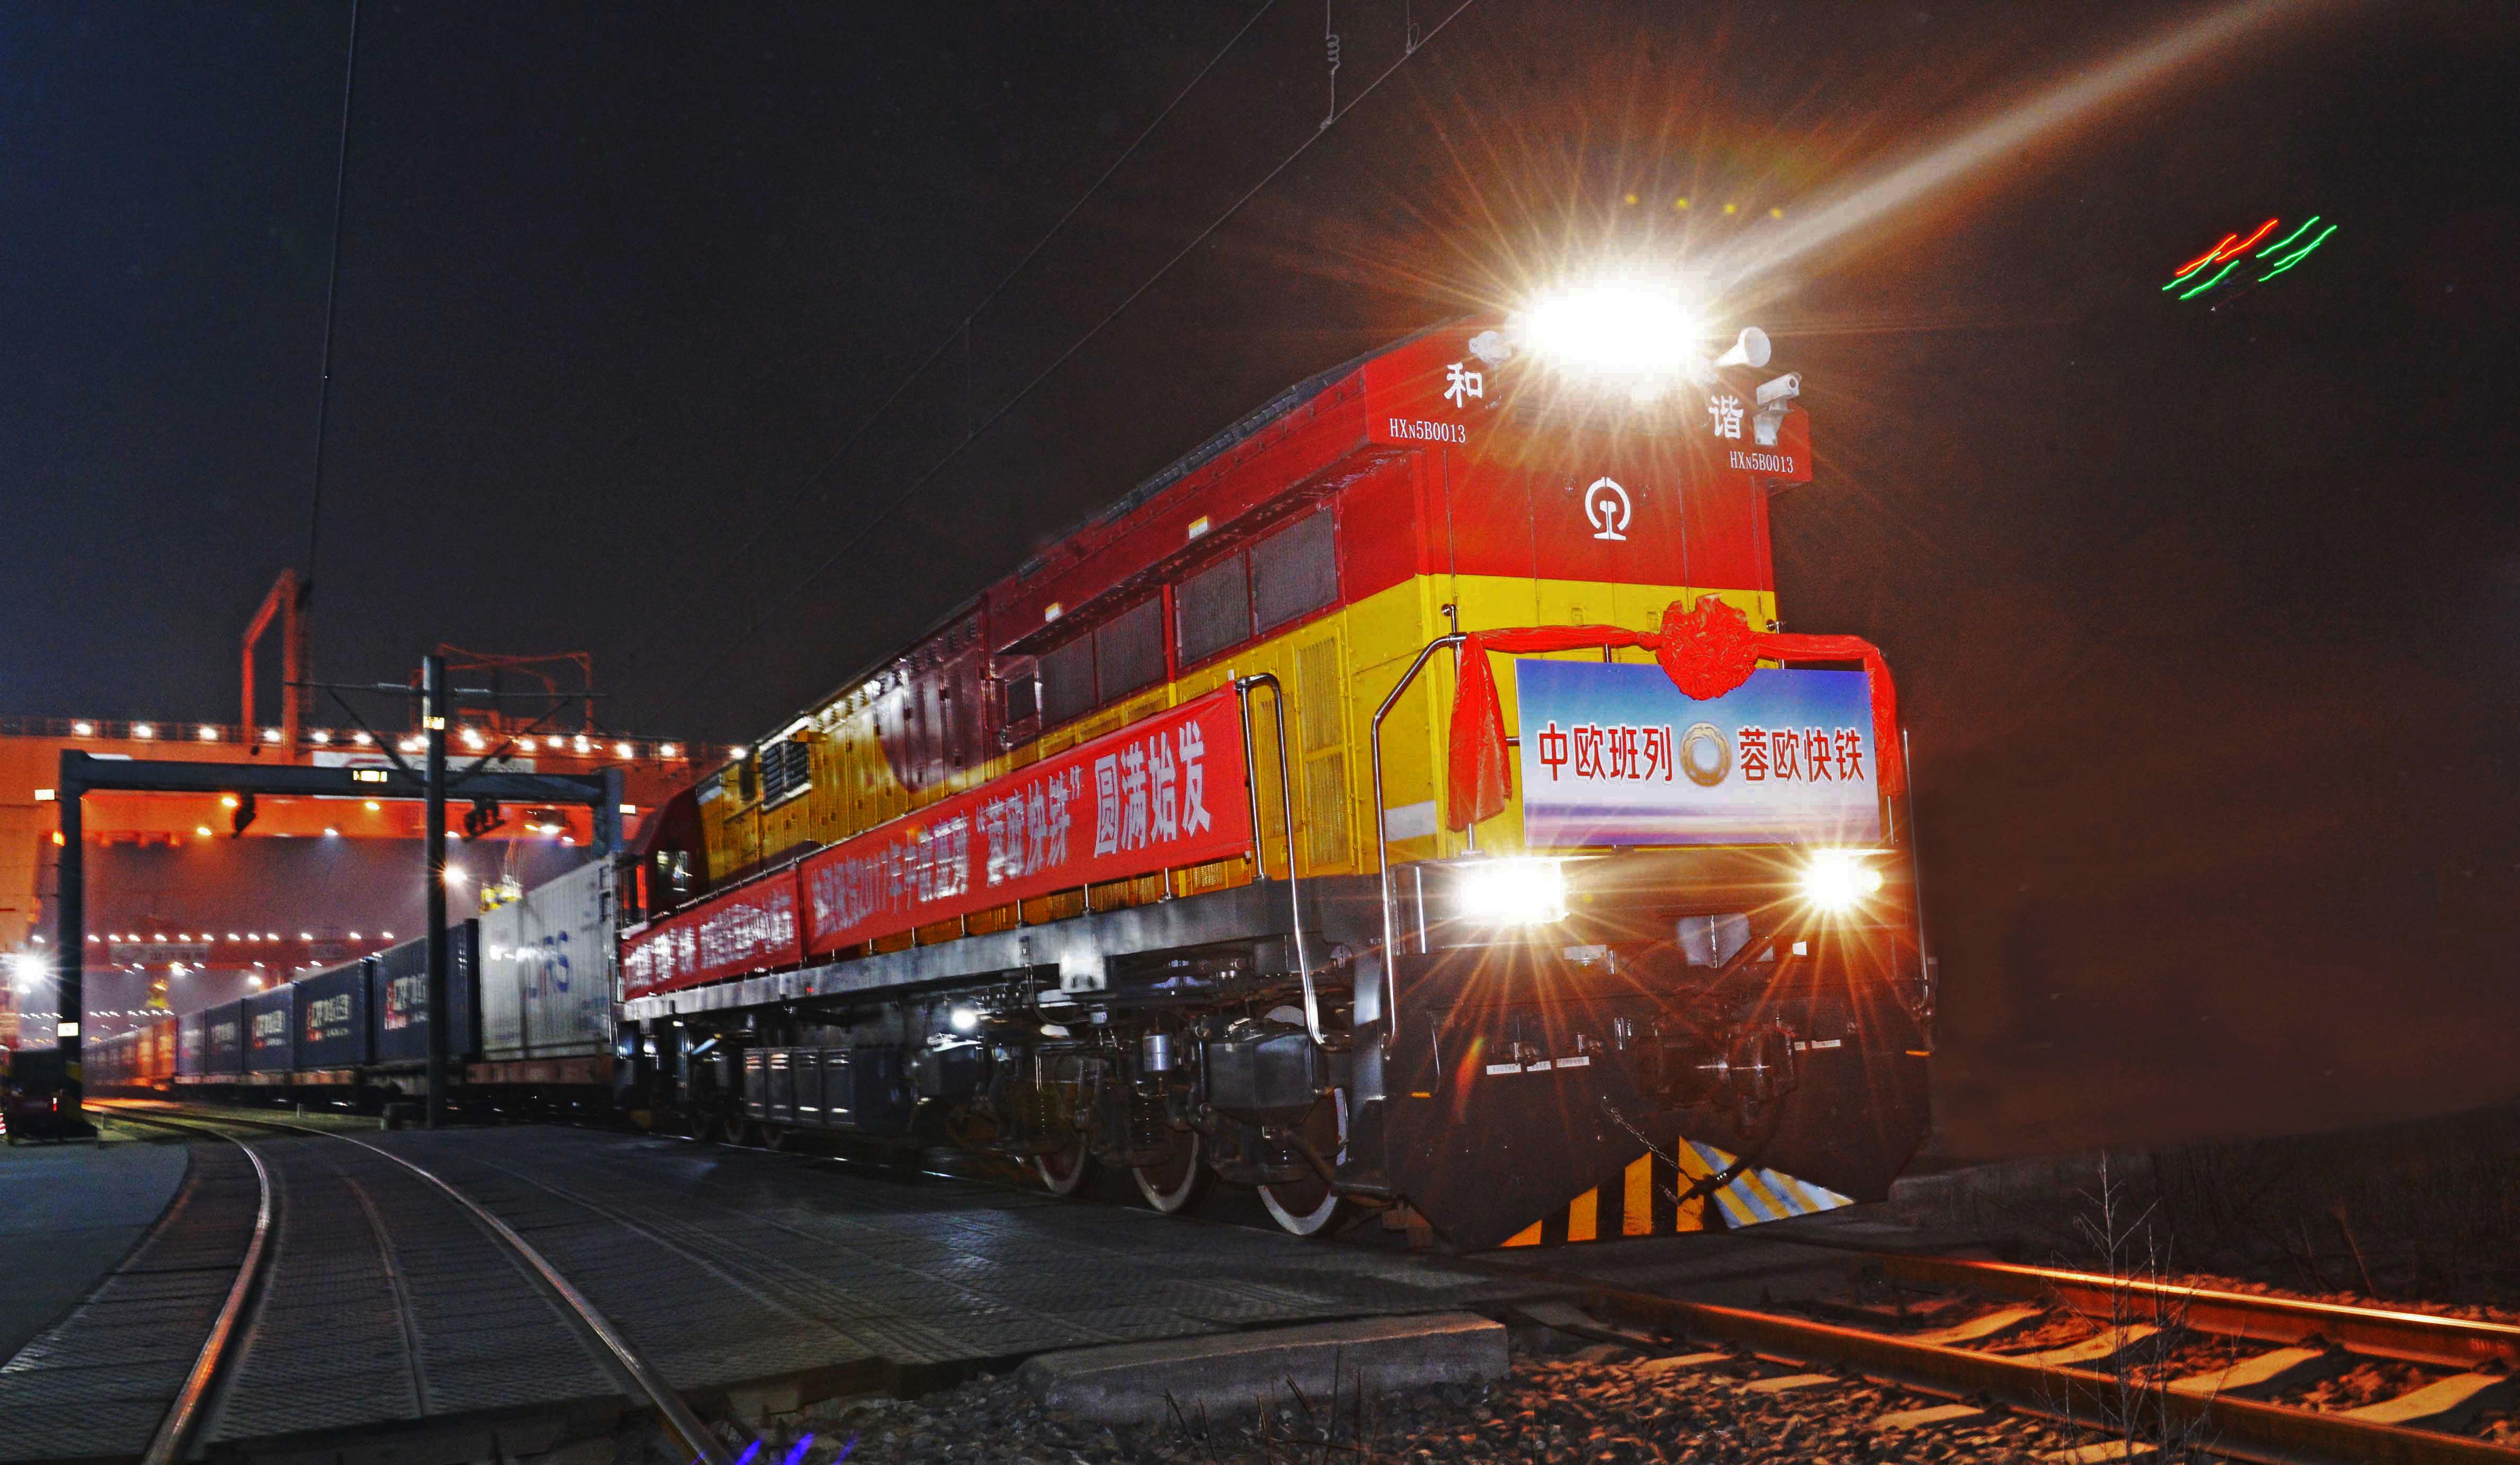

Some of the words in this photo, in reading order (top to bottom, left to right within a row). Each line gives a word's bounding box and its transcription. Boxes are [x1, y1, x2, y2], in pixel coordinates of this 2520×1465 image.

[1444, 362, 1483, 407] 和
[1708, 394, 1744, 439] 谐
[1539, 723, 1672, 781] 中欧班列
[1738, 729, 1865, 782] 蓉欧快铁
[1094, 720, 1210, 858] 圆满始发
